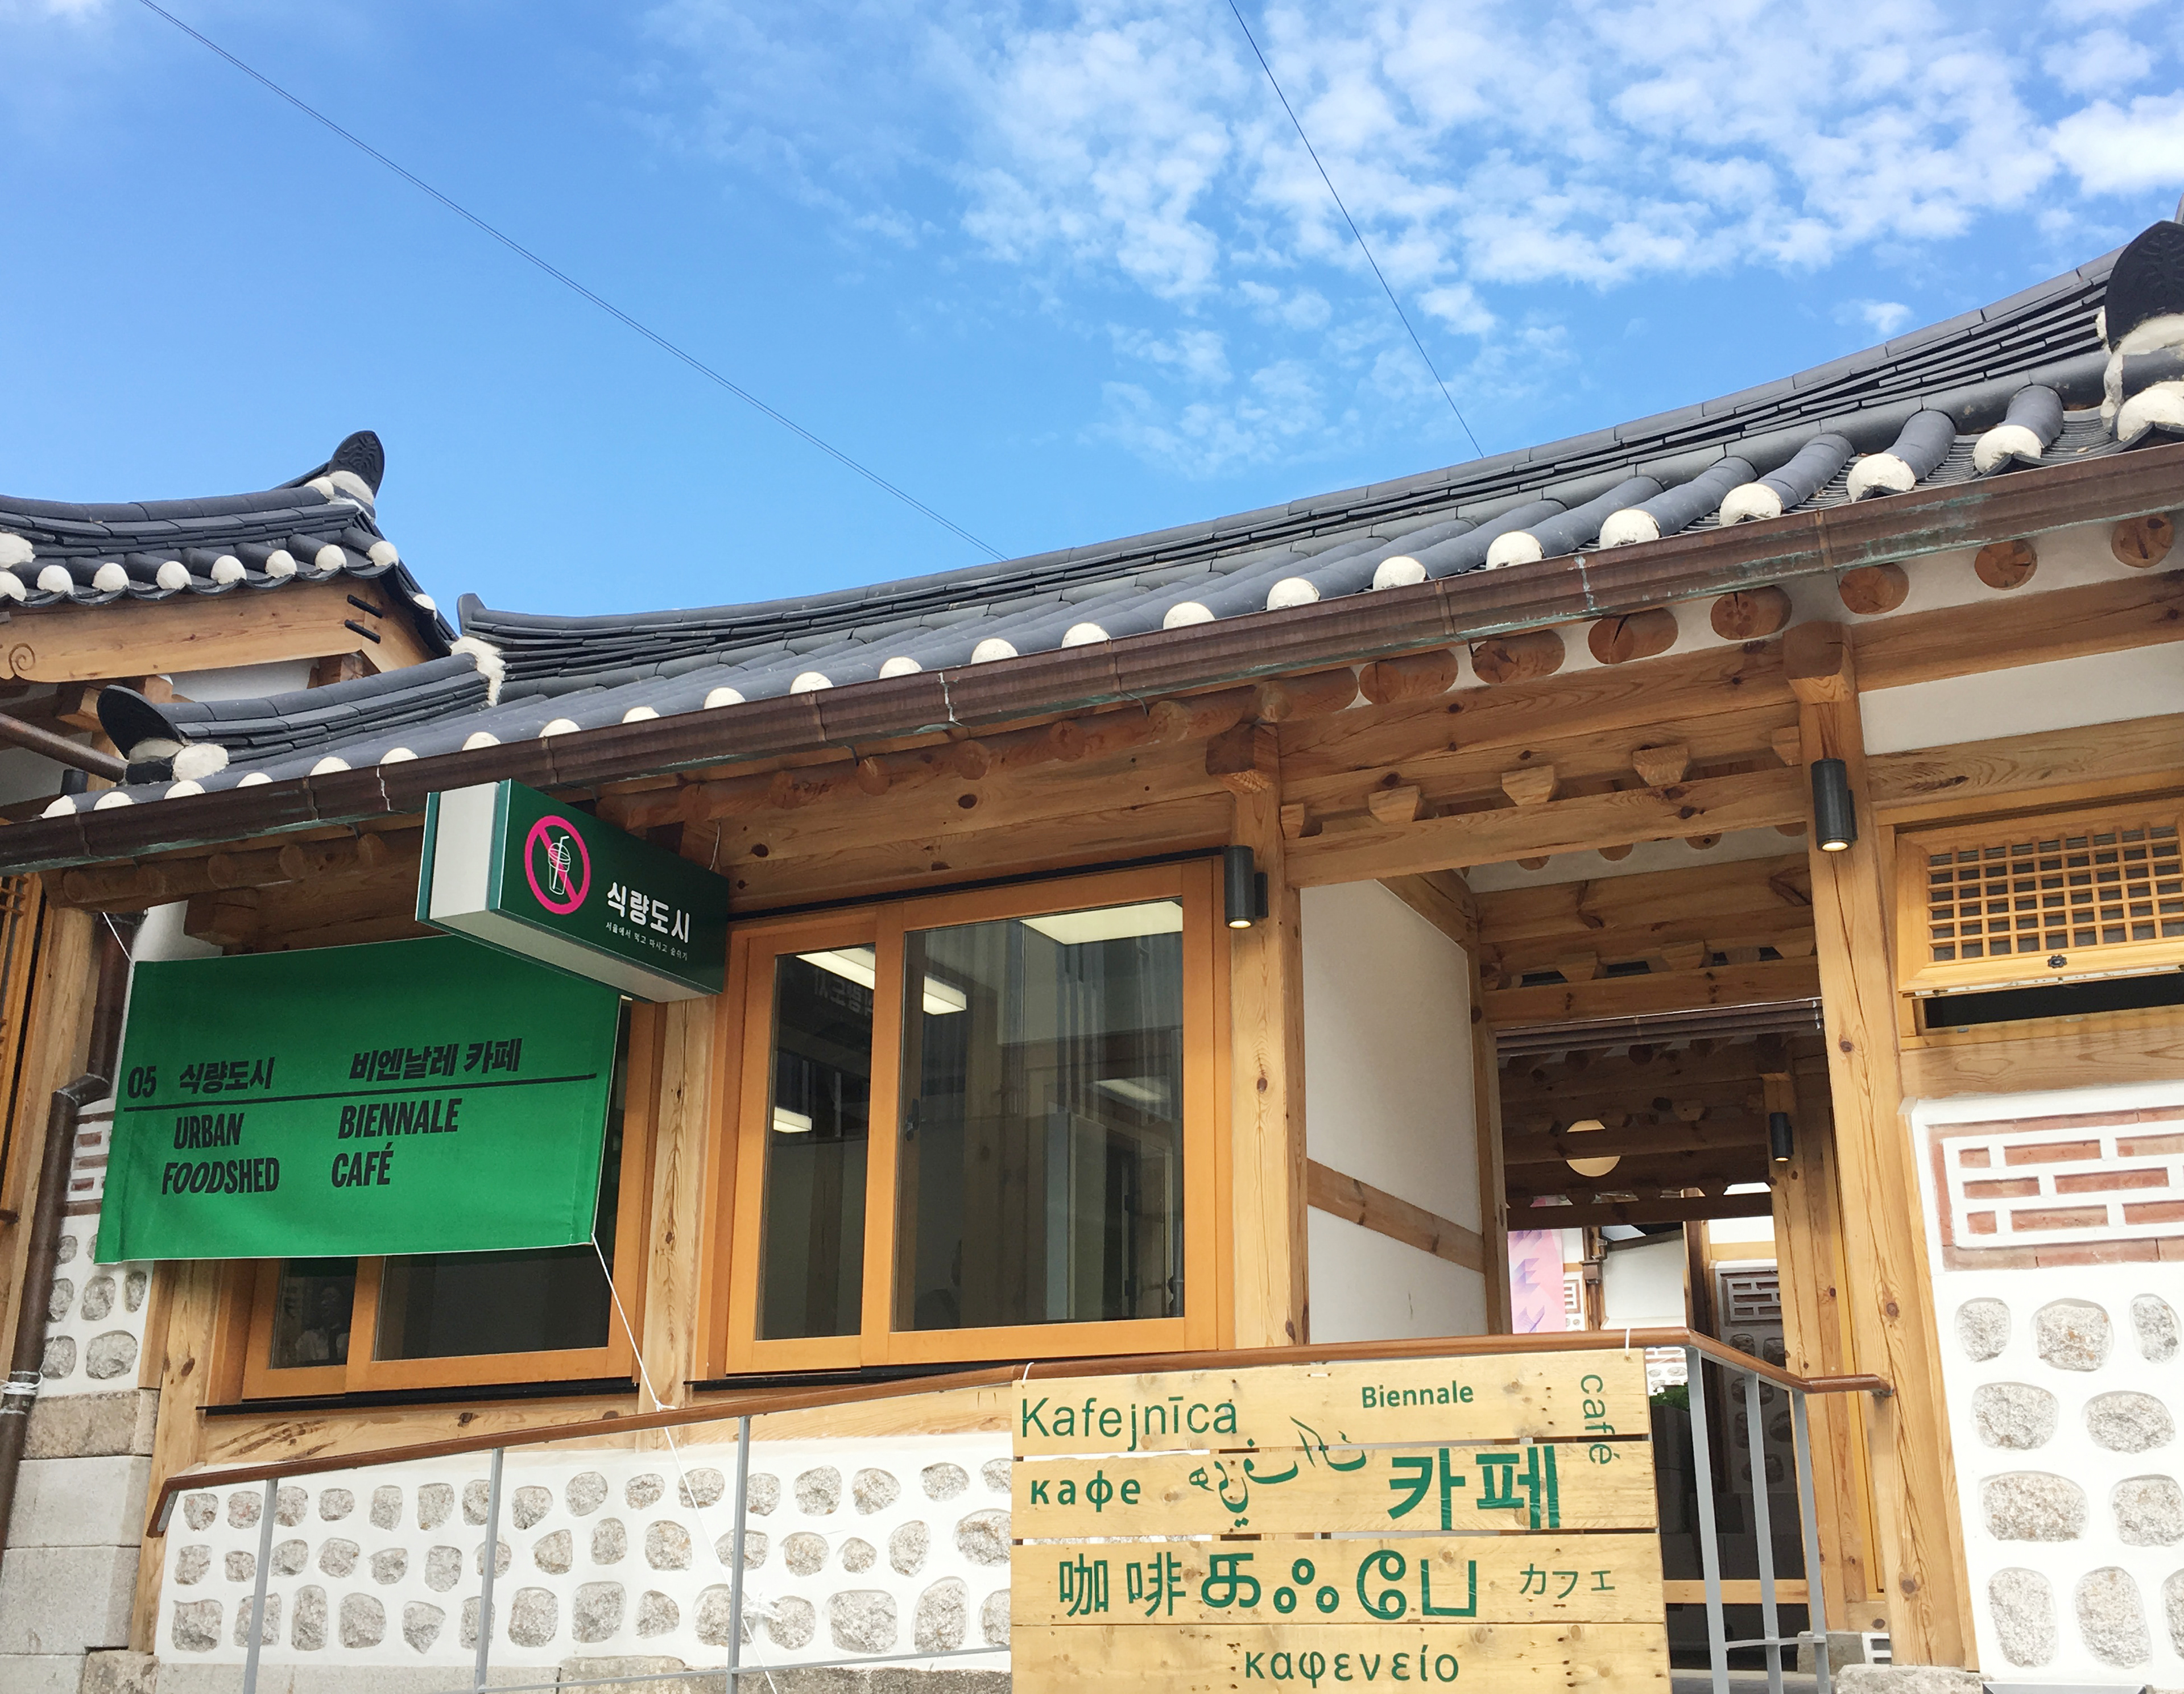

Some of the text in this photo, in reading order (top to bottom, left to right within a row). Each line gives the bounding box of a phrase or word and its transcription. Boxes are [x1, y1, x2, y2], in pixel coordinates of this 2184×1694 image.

[607, 882, 690, 944] 식량도시
[606, 922, 631, 939] 서울에서
[634, 932, 647, 945] 먹고
[649, 939, 668, 953] 마시고
[127, 1065, 157, 1098] 05
[179, 1056, 275, 1095] 식량도시
[349, 1038, 522, 1082] 비엔날레 카페
[173, 1112, 245, 1150] URBAN
[337, 1098, 462, 1139] BIENNALE
[162, 1157, 280, 1195] FOODSHED
[331, 1141, 394, 1188] CAFÉ
[1362, 1380, 1474, 1409] Biennale
[1022, 1395, 1238, 1452] Kafejnīca
[1580, 1374, 1621, 1465] café
[1031, 1470, 1141, 1513] кафе
[1387, 1444, 1561, 1531] 카페
[1059, 1551, 1186, 1618] 咖啡
[1519, 1563, 1616, 1600] カフェ
[1245, 1644, 1459, 1689] καφενείο
